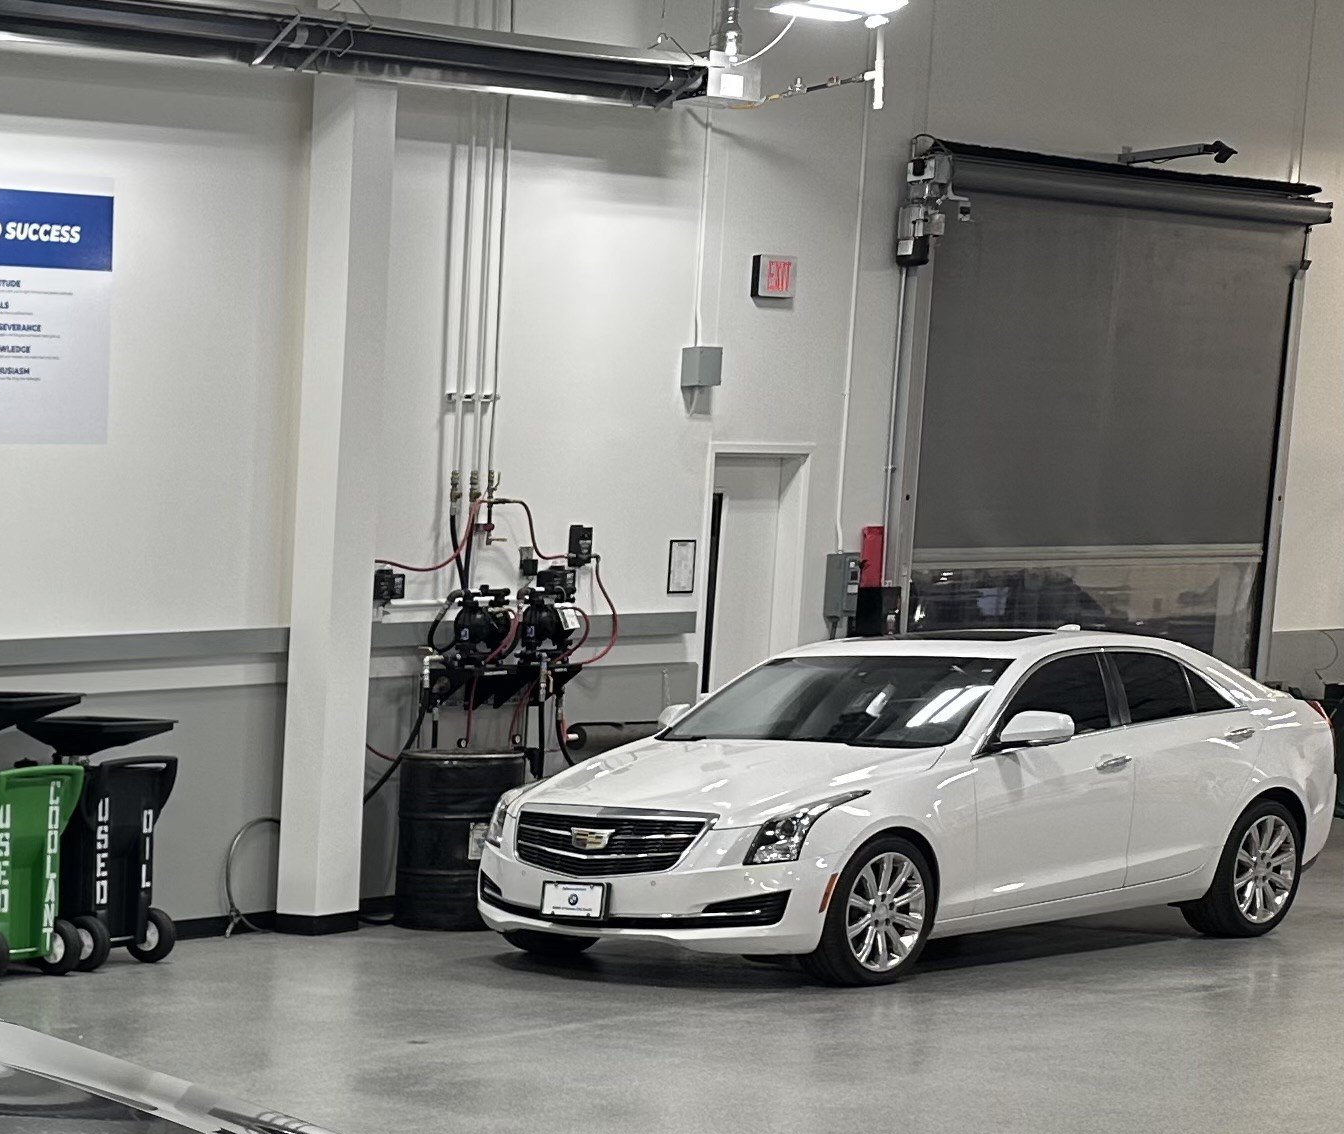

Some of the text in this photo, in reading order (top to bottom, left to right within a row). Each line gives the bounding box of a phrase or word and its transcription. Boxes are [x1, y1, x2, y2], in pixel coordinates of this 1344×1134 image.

[4, 221, 81, 244] SUCCESS
[42, 780, 61, 951] COOLANT
[95, 797, 110, 905] USED
[140, 808, 154, 889] OIL
